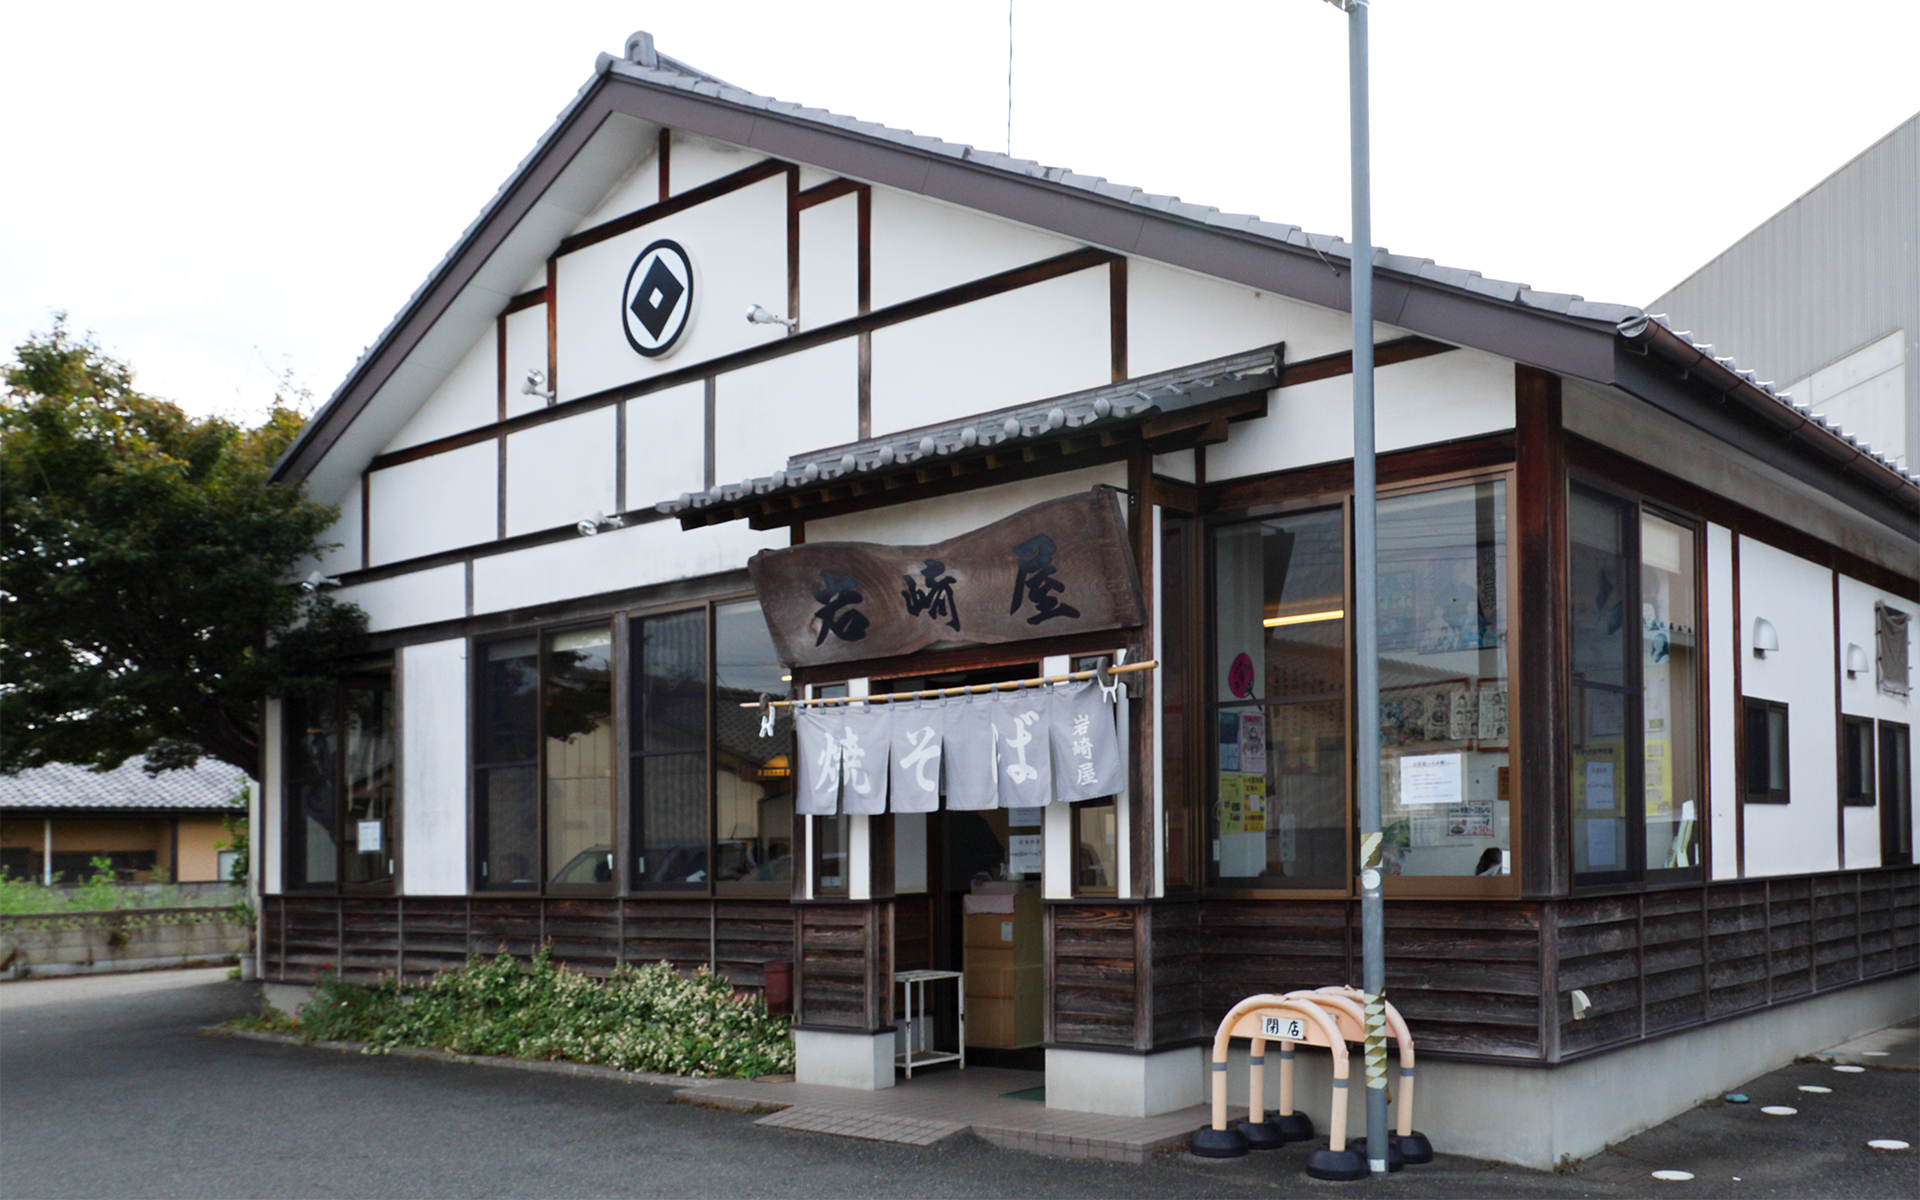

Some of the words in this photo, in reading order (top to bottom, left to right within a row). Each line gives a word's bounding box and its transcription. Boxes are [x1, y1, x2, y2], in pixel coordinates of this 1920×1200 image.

[812, 533, 1082, 647] 岩崎屋
[814, 711, 1041, 794] 焼そば
[1072, 713, 1099, 786] 岩崎屋
[1266, 1017, 1300, 1037] 閉店
